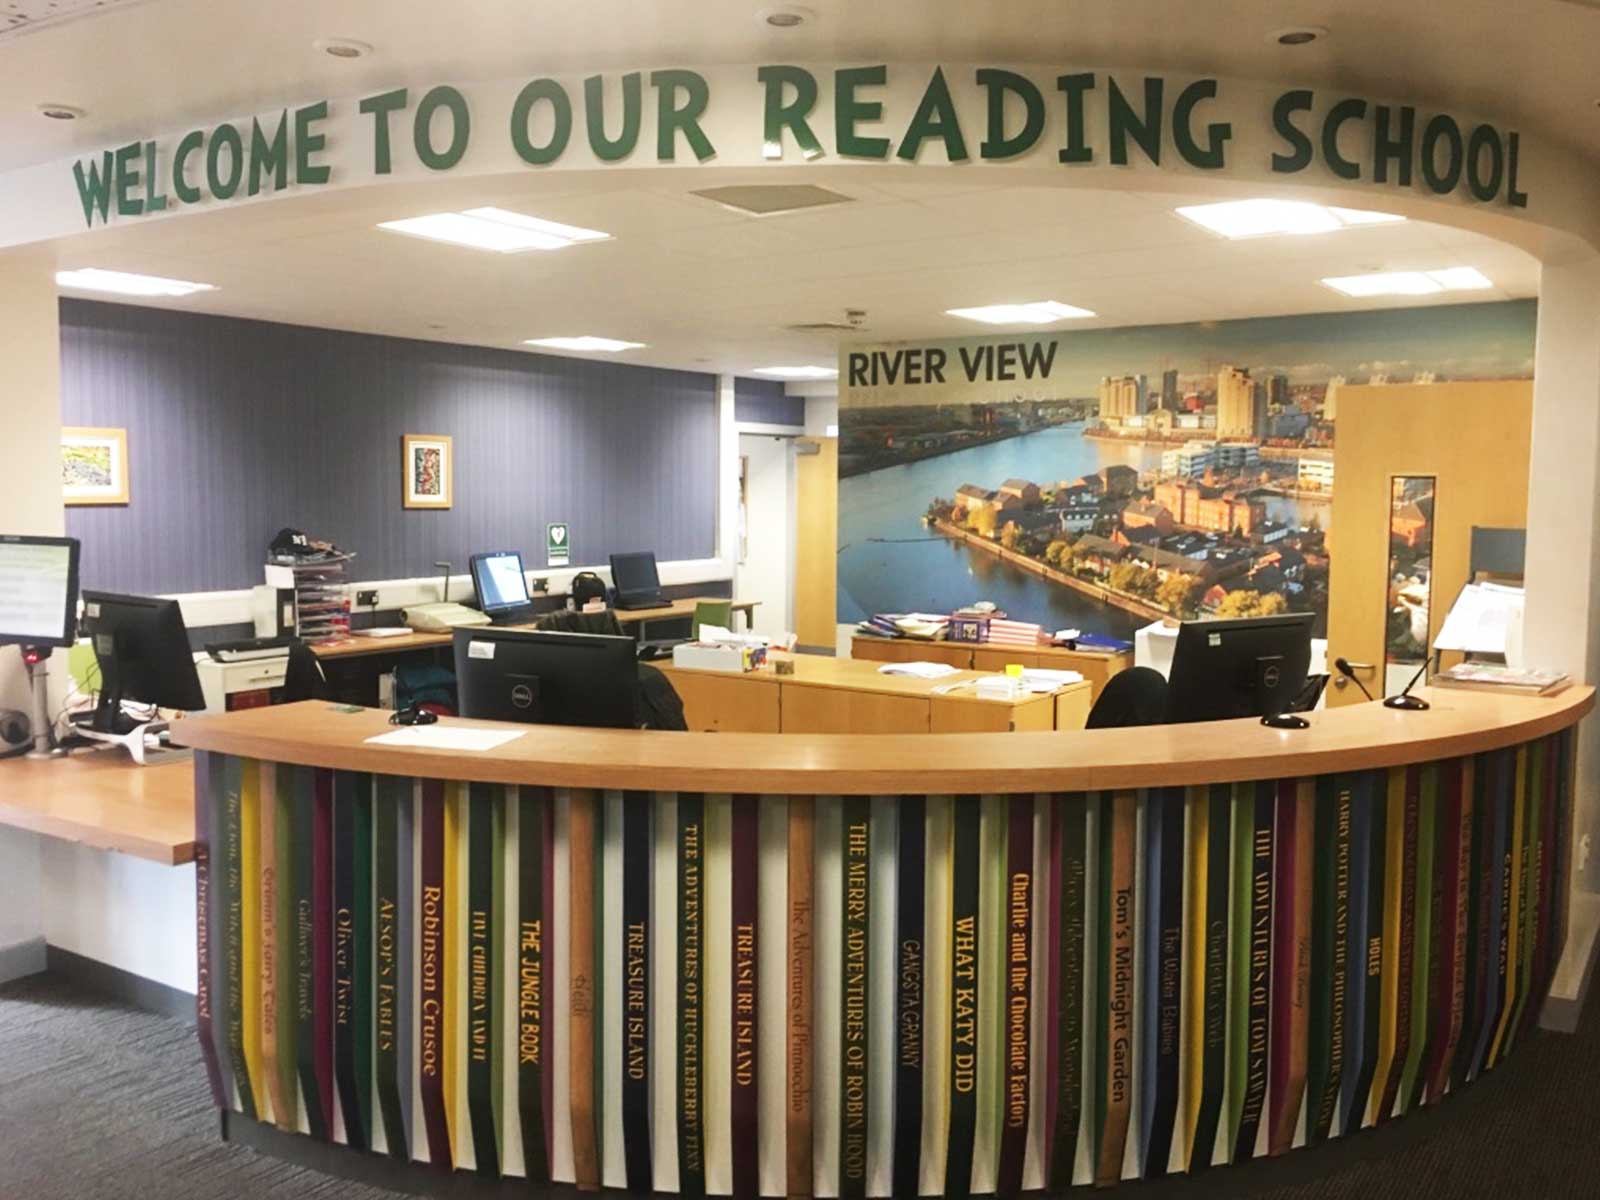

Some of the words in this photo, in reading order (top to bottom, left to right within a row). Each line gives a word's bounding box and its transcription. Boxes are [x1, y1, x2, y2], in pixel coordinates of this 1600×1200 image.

[73, 101, 331, 228] WELCOME
[360, 87, 470, 174] TO
[511, 69, 715, 164] OUR
[757, 65, 1232, 169] READING
[1272, 90, 1528, 208] SCHOOL
[849, 348, 947, 387] RIVER
[958, 341, 1058, 382] VIEW
[849, 823, 867, 857] THE
[1338, 790, 1352, 837] HARRY
[684, 824, 698, 859] THE
[1255, 829, 1271, 858] THE
[848, 862, 867, 922] MERRY
[1336, 843, 1350, 900] POTTER
[472, 910, 487, 939] FIVE
[684, 863, 698, 978] ADVENTURES
[792, 900, 809, 925] The
[1012, 873, 1030, 927] Charlie
[1115, 887, 1132, 940] Tom's
[1253, 870, 1270, 982] ADVENTURES
[1336, 904, 1348, 935] AND
[336, 908, 352, 969] Oliver
[423, 886, 440, 991] Robinson
[521, 920, 541, 952] THE
[956, 916, 975, 980] WHAT
[1012, 932, 1029, 961] and
[1164, 926, 1180, 953] The
[1335, 939, 1347, 966] THE
[1367, 937, 1381, 976] HOLES
[472, 945, 487, 1011] CHILDREN
[521, 957, 541, 1019] JUNGLE
[628, 921, 645, 1011] TREASURE
[737, 922, 754, 1015] TREASURE
[792, 930, 809, 1010] Adventures
[847, 926, 866, 1042] ADVENTURES
[902, 940, 920, 1009] GANGSTA
[1011, 967, 1028, 991] the
[1111, 946, 1130, 1031] Midnight
[1163, 960, 1179, 999] Water
[337, 978, 352, 1024] Twist
[380, 983, 394, 1051] FABLES
[684, 982, 698, 1005] OF
[955, 987, 975, 1048] KATY
[1252, 987, 1268, 1007] OF
[423, 999, 440, 1076] Crusoe
[472, 1020, 487, 1044] AND
[520, 1023, 540, 1064] BOOK
[628, 1017, 645, 1079] ISLAND
[792, 1014, 809, 1033] of
[901, 1011, 920, 1070] GRANNY
[1011, 996, 1029, 1070] Chocolate
[1161, 1006, 1178, 1055] Babies
[1250, 1019, 1267, 1053] TOM
[684, 1008, 698, 1128] HUCKLEBERRY
[736, 1020, 753, 1086] ISLAND
[847, 1046, 865, 1071] OF
[955, 1054, 974, 1093] DID
[1112, 1036, 1129, 1104] Garden
[847, 1075, 864, 1130] ROBIN
[1009, 1074, 1028, 1128] Factory
[846, 1133, 864, 1180] HOOD
